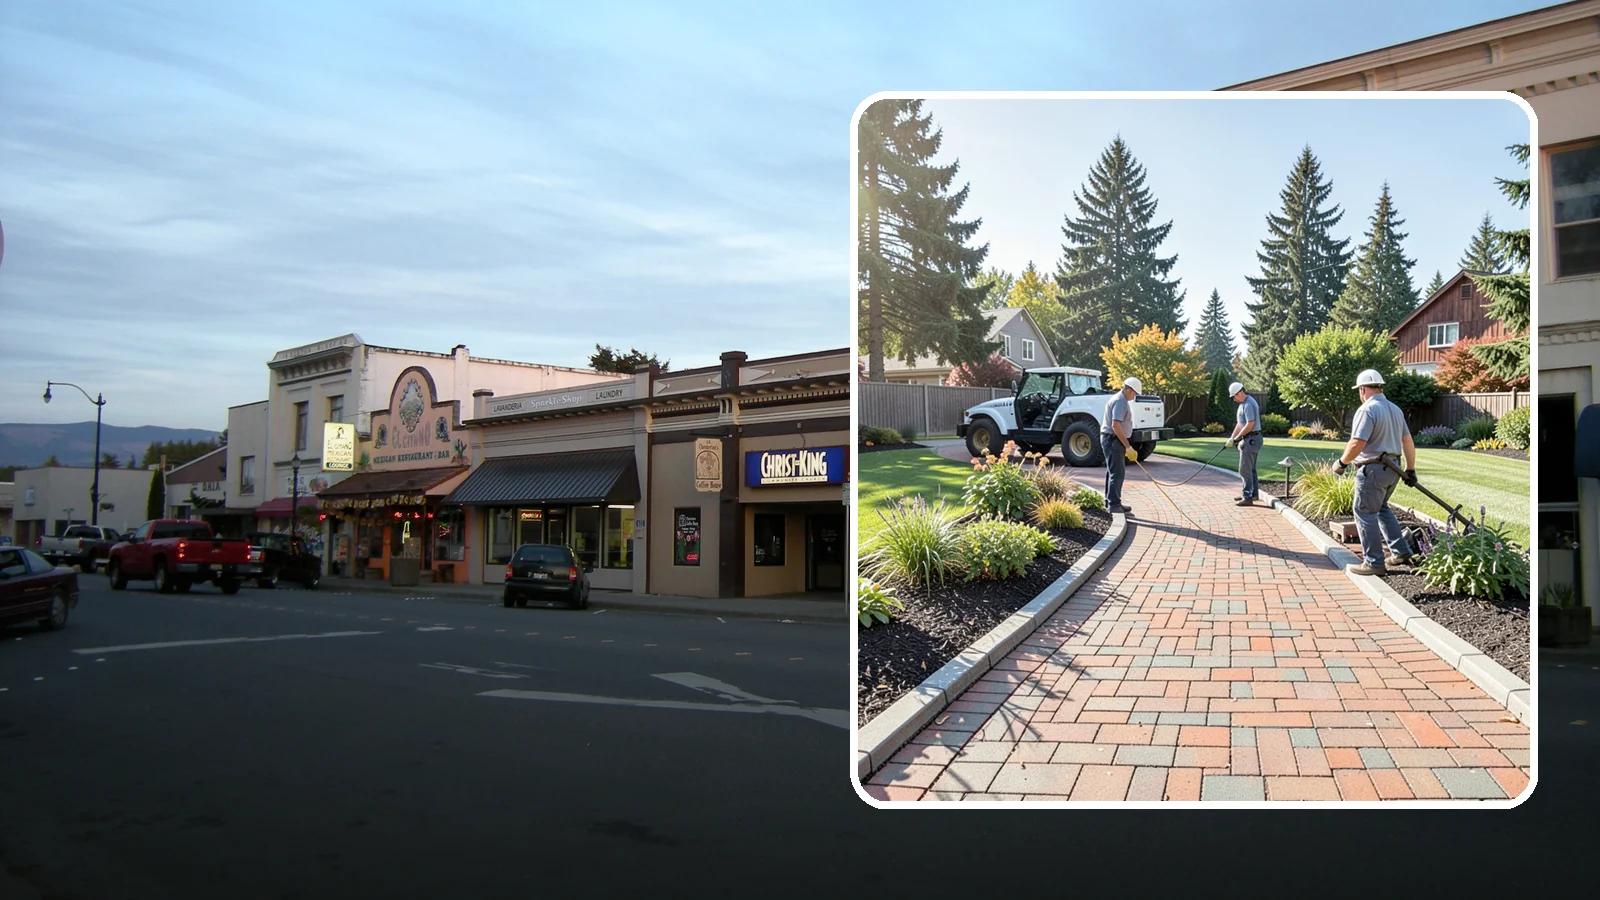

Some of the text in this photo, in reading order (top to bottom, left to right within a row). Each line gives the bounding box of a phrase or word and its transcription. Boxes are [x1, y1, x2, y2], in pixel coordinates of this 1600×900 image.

[595, 389, 623, 400] LAUNDRY
[494, 402, 522, 412] LAVANDERIA
[531, 395, 582, 409] Sparkle Shop
[373, 454, 396, 464] MEXICAN
[397, 451, 433, 462] RESTAURANT
[437, 450, 450, 459] BAR
[761, 452, 797, 478] CHRIST
[799, 450, 827, 476] KING
